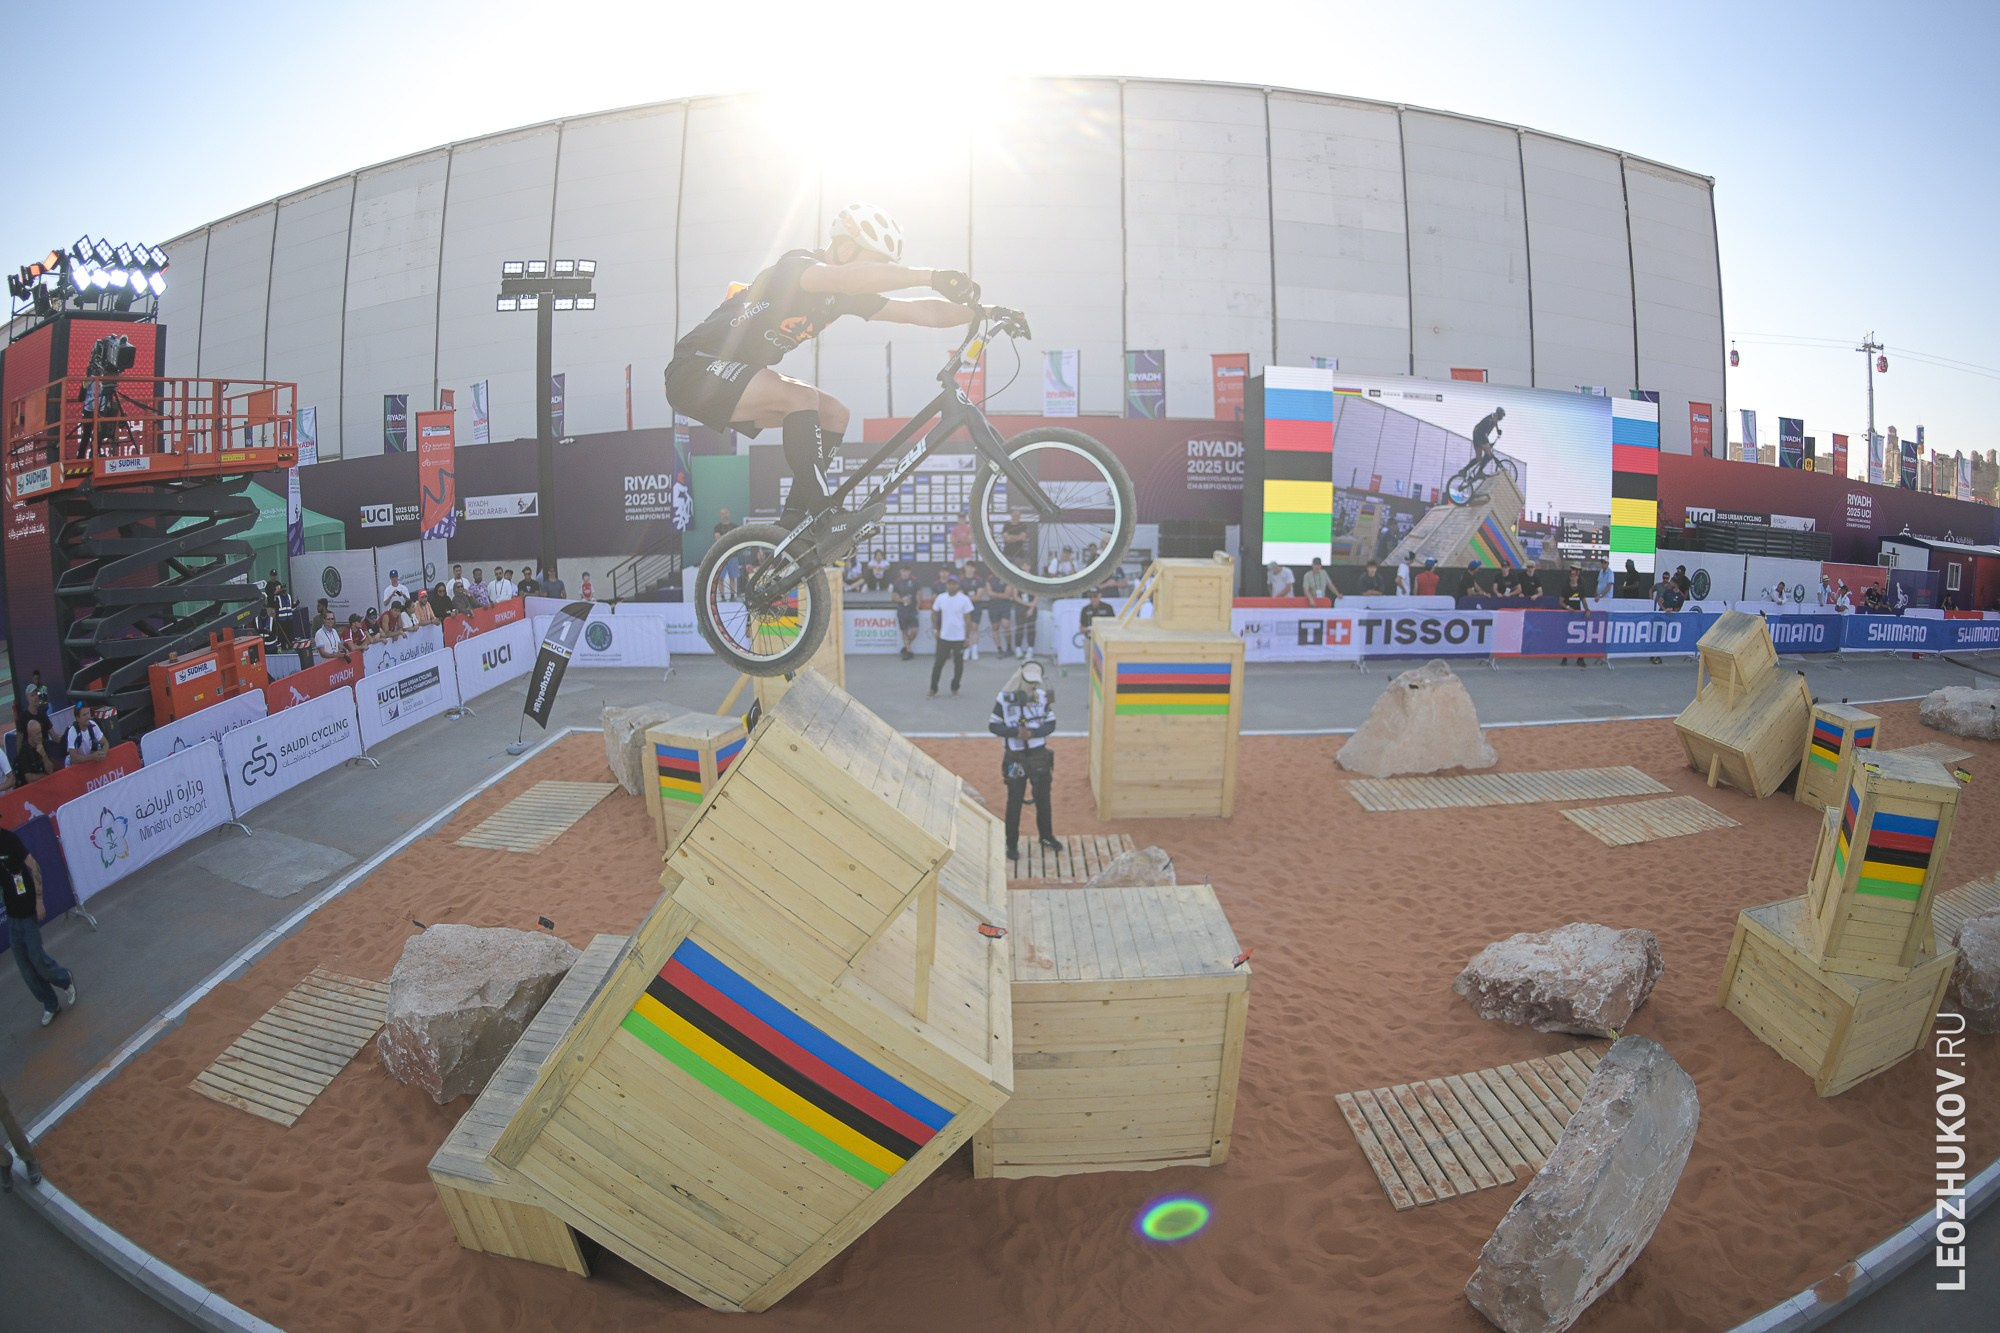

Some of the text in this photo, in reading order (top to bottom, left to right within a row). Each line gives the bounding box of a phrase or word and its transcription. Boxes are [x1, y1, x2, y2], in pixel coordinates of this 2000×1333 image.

[730, 300, 770, 328] Cofidis
[1128, 373, 1161, 381] RIYADH
[1781, 435, 1801, 443] RIYADH
[118, 459, 141, 468] SUDHIR
[1187, 460, 1245, 474] 2025 UC
[26, 468, 48, 486] SUDHIR
[624, 474, 672, 491] RIYAD
[468, 500, 489, 508] RIYADH
[625, 492, 656, 506] 2025
[1847, 493, 1872, 508] RIYADH
[366, 508, 391, 523] UCI
[395, 505, 420, 514] 2025 URB
[468, 509, 484, 517] SAUDI
[486, 507, 508, 516] ARABIA
[1847, 507, 1872, 519] 2025 UCI
[395, 513, 416, 522] WORLD
[1691, 511, 1715, 525] UCI
[1717, 512, 1762, 523] 2025 URBAN CYCLING
[494, 609, 516, 623] RIYADH
[854, 617, 897, 628] RIYADH
[559, 620, 573, 642] 1
[854, 629, 877, 638] 2025
[1358, 618, 1493, 645] TISSOT
[1567, 621, 1682, 644] SHIMANO
[1766, 623, 1825, 643] IMANO
[1868, 623, 1927, 643] SHIMANO
[1957, 626, 2000, 643] SHIMANO
[550, 643, 565, 655] UCI
[487, 644, 512, 670] UCI
[187, 663, 209, 676] SUDHIR
[329, 668, 354, 686] RIYADH
[532, 660, 556, 713] #Riyadh2025
[381, 687, 398, 703] UCI
[280, 718, 349, 757] SAUDI CYCLING
[86, 767, 125, 793] RIYADH
[135, 780, 204, 820] وزارة الرياضة
[139, 796, 208, 842] Ministry of Sport
